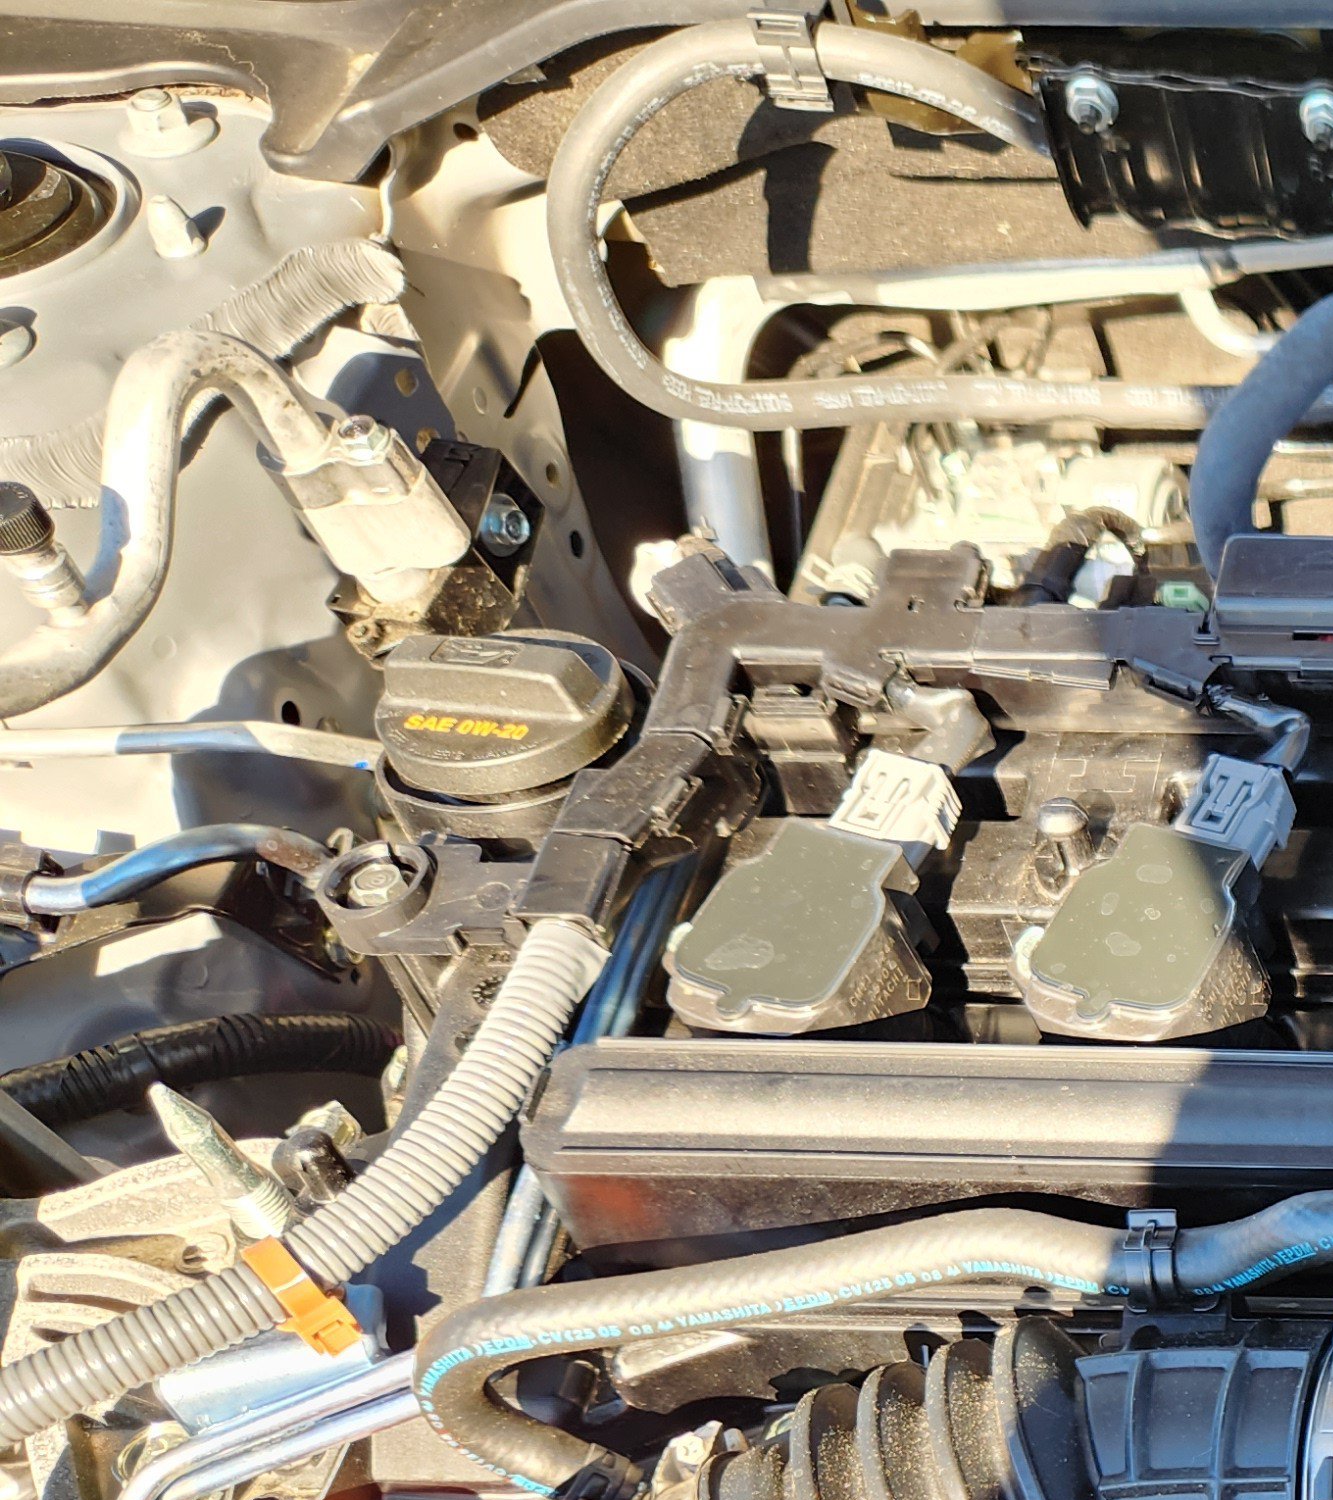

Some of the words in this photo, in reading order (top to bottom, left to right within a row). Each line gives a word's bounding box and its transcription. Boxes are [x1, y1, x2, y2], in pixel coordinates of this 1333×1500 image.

[403, 714, 456, 733] SAE
[457, 719, 530, 740] 0W-20
[1224, 1259, 1277, 1290] YAMASHITA
[420, 1346, 477, 1398] YAMASHITA
[675, 1302, 773, 1328] YAMASHITA
[962, 1259, 1044, 1280] YAMASHITA
